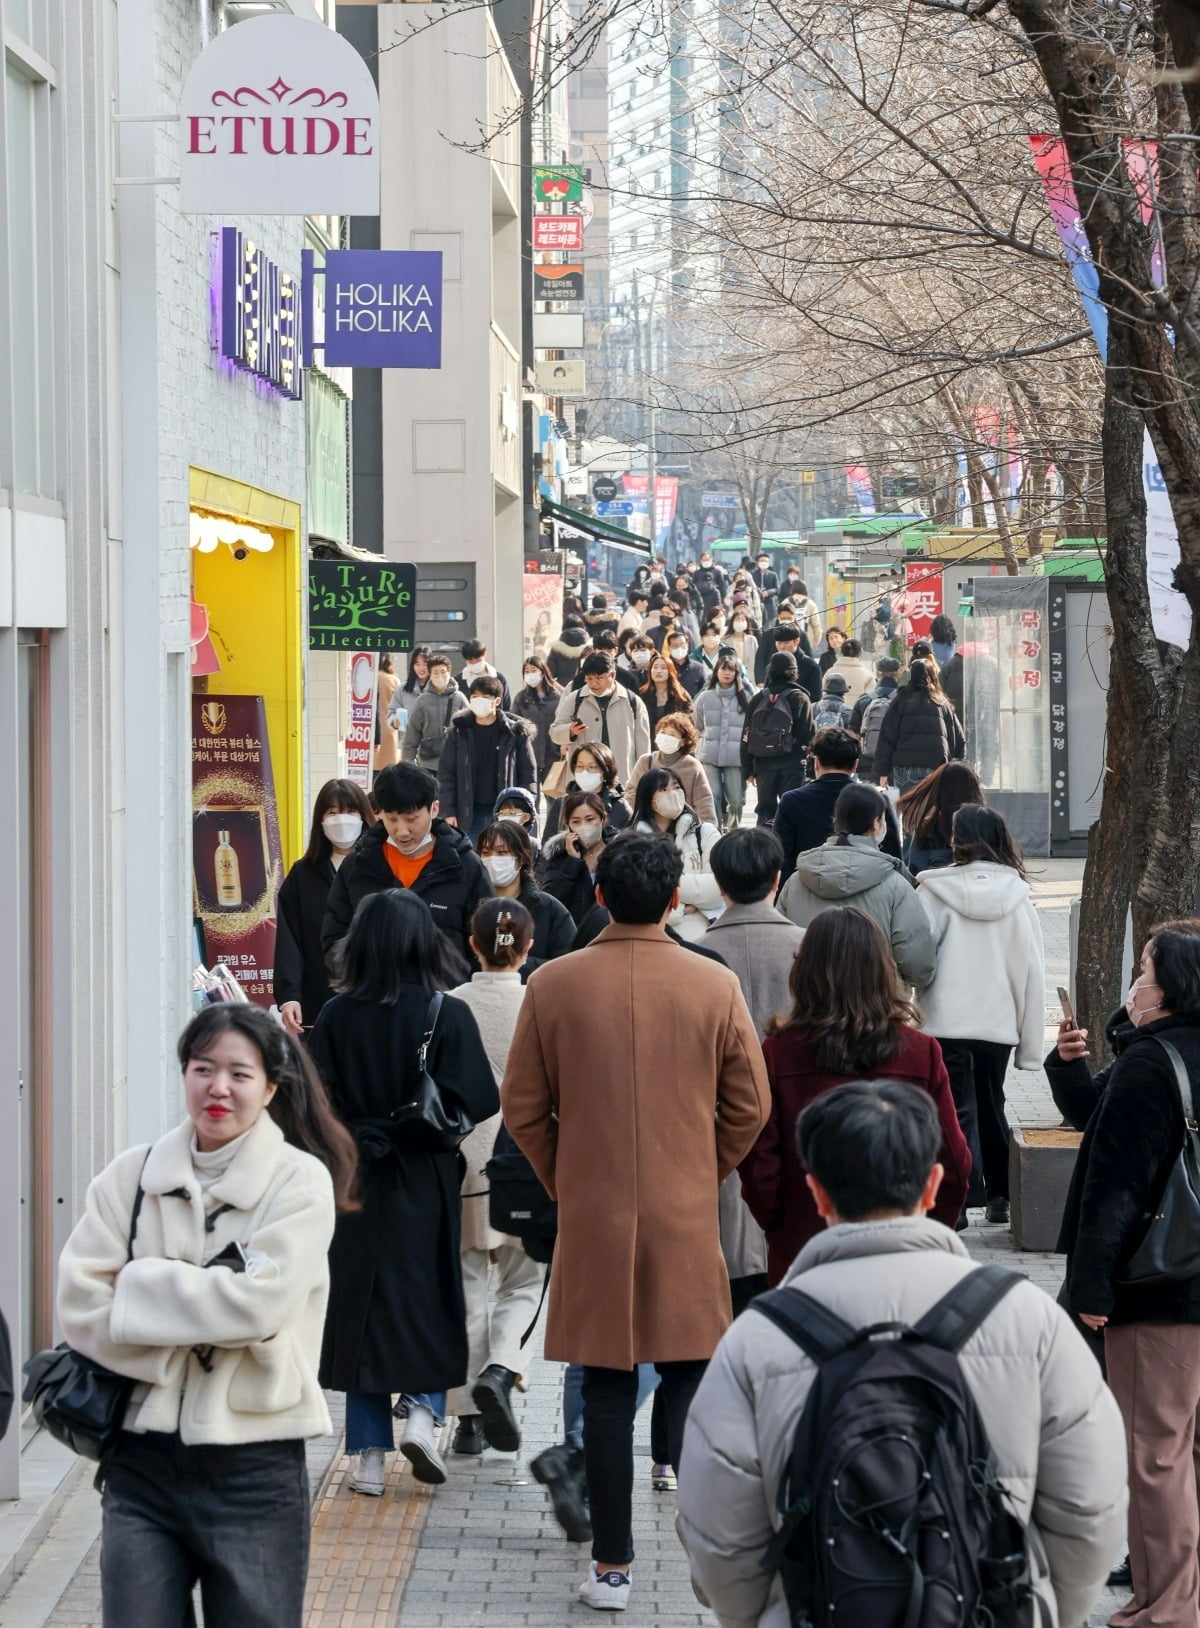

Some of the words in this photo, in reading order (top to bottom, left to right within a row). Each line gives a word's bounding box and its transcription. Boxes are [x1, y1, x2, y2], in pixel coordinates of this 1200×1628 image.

[186, 115, 373, 156] ETUDE
[335, 283, 432, 307] HOLIKA
[335, 309, 432, 333] HOLIKA
[1021, 610, 1040, 688] 닭강정
[1052, 704, 1066, 750] 닭강정
[199, 738, 228, 748] 대한민국
[230, 738, 244, 748] 뷰티
[246, 739, 262, 749] 헬스
[214, 751, 228, 762] 부문
[230, 752, 260, 762] 대상기념
[240, 955, 257, 965] 유스
[251, 984, 264, 993] 순금
